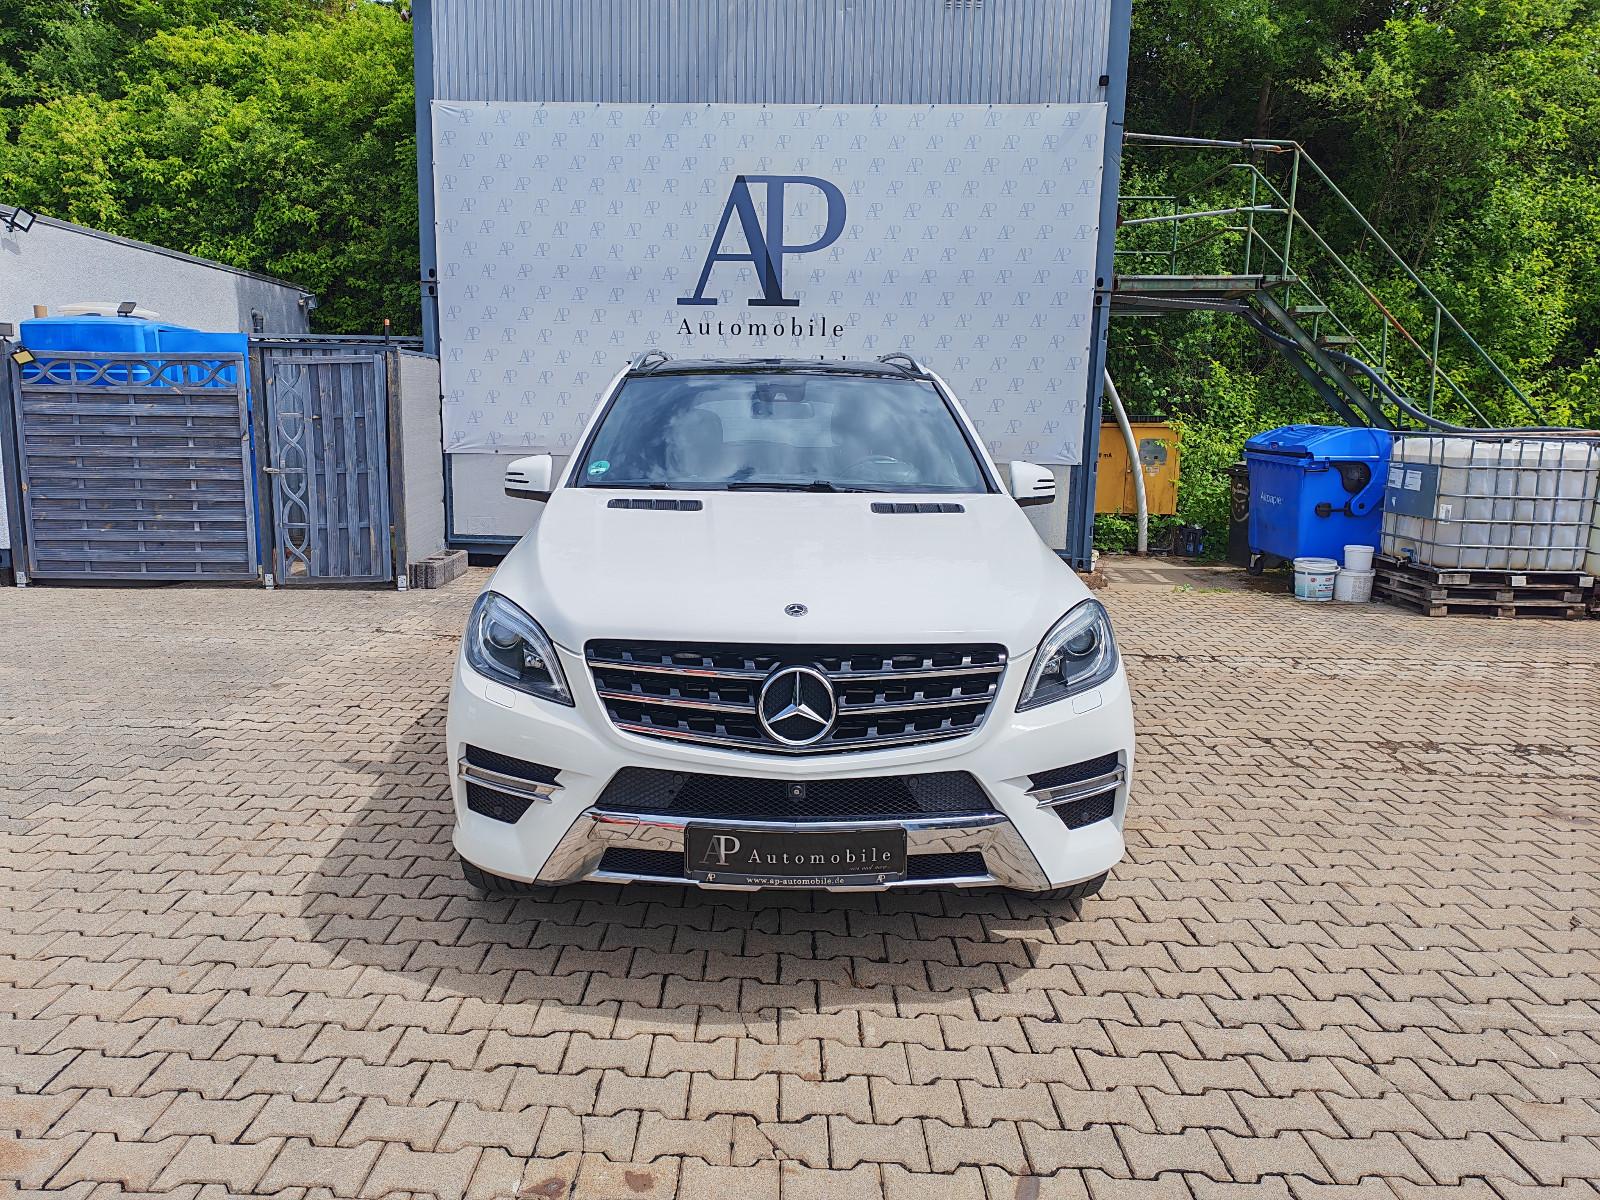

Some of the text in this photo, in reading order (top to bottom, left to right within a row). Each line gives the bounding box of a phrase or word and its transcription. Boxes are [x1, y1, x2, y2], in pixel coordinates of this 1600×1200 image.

[494, 109, 512, 124] AP
[531, 110, 548, 124] AP
[568, 110, 586, 125] AP
[606, 110, 623, 126] AP
[680, 111, 698, 126] AP
[718, 112, 736, 126] AP
[756, 112, 773, 126] AP
[831, 112, 849, 127] AP
[870, 112, 887, 127] AP
[908, 112, 925, 128] AP
[1024, 112, 1041, 126] AP
[439, 130, 456, 145] AP
[476, 131, 494, 146] AP
[550, 132, 568, 147] AP
[587, 133, 604, 148] AP
[624, 133, 642, 148] AP
[699, 134, 716, 149] AP
[736, 134, 754, 149] AP
[774, 134, 792, 149] AP
[850, 135, 867, 150] AP
[926, 135, 943, 150] AP
[964, 135, 982, 150] AP
[1003, 134, 1020, 150] AP
[1080, 134, 1098, 149] AP
[458, 153, 475, 168] AP
[532, 154, 549, 169] AP
[569, 155, 586, 170] AP
[643, 156, 660, 171] AP
[680, 156, 698, 171] AP
[717, 156, 735, 172] AP
[792, 157, 810, 172] AP
[830, 157, 848, 172] AP
[868, 158, 885, 172] AP
[906, 158, 923, 172] AP
[982, 158, 1000, 172] AP
[1021, 157, 1038, 172] AP
[1059, 157, 1077, 172] AP
[477, 175, 494, 190] AP
[514, 176, 531, 191] AP
[551, 177, 568, 192] AP
[624, 178, 642, 193] AP
[661, 178, 679, 193] AP
[848, 180, 866, 195] AP
[886, 180, 903, 195] AP
[924, 180, 941, 195] AP
[1000, 180, 1017, 195] AP
[1038, 180, 1056, 195] AP
[459, 197, 476, 212] AP
[496, 198, 514, 213] AP
[569, 199, 587, 214] AP
[643, 200, 660, 215] AP
[680, 201, 698, 216] AP
[791, 202, 808, 217] AP
[904, 202, 921, 218] AP
[941, 203, 959, 218] AP
[1018, 202, 1035, 218] AP
[1056, 202, 1074, 217] AP
[478, 219, 496, 234] AP
[515, 220, 532, 235] AP
[551, 221, 569, 236] AP
[625, 222, 642, 237] AP
[661, 222, 679, 238] AP
[846, 224, 864, 240] AP
[884, 225, 902, 240] AP
[922, 225, 939, 240] AP
[997, 225, 1015, 240] AP
[1036, 224, 1053, 240] AP
[677, 175, 847, 306] AP
[497, 241, 514, 256] AP
[534, 242, 551, 257] AP
[570, 243, 588, 258] AP
[643, 244, 661, 259] AP
[680, 245, 698, 260] AP
[864, 247, 882, 262] AP
[902, 247, 919, 262] AP
[939, 247, 957, 262] AP
[977, 247, 994, 262] AP
[1015, 247, 1032, 262] AP
[443, 262, 460, 277] AP
[516, 263, 534, 278] AP
[552, 264, 570, 279] AP
[589, 265, 606, 280] AP
[662, 266, 679, 281] AP
[808, 268, 826, 283] AP
[845, 269, 862, 284] AP
[882, 269, 900, 284] AP
[957, 269, 974, 284] AP
[995, 269, 1012, 284] AP
[1033, 269, 1050, 284] AP
[1071, 269, 1088, 284] AP
[462, 284, 480, 299] AP
[571, 286, 588, 301] AP
[607, 287, 625, 302] AP
[643, 288, 661, 302] AP
[826, 290, 844, 305] AP
[863, 291, 880, 306] AP
[937, 291, 955, 306] AP
[975, 291, 992, 306] AP
[1012, 291, 1030, 306] AP
[1051, 291, 1068, 306] AP
[445, 304, 462, 320] AP
[517, 306, 534, 321] AP
[589, 308, 607, 323] AP
[662, 309, 679, 324] AP
[844, 312, 861, 327] AP
[880, 312, 898, 327] AP
[676, 316, 844, 336] Automobile
[955, 313, 972, 328] AP
[992, 313, 1010, 328] AP
[1068, 313, 1085, 328] AP
[463, 326, 481, 341] AP
[499, 327, 517, 342] AP
[572, 329, 589, 344] AP
[608, 329, 625, 344] AP
[861, 334, 879, 349] AP
[898, 334, 916, 349] AP
[935, 334, 952, 349] AP
[1010, 334, 1027, 349] AP
[1047, 334, 1065, 349] AP
[446, 347, 464, 362] AP
[518, 348, 536, 363] AP
[554, 349, 572, 364] AP
[590, 350, 607, 365] AP
[990, 356, 1007, 371] AP
[1027, 356, 1044, 371] AP
[1065, 356, 1082, 371] AP
[465, 368, 482, 383] AP
[536, 370, 554, 385] AP
[970, 377, 988, 392] AP
[1007, 377, 1024, 392] AP
[1045, 377, 1062, 392] AP
[483, 389, 501, 404] AP
[519, 390, 536, 405] AP
[987, 398, 1005, 413] AP
[1025, 398, 1042, 413] AP
[1062, 399, 1080, 414] AP
[502, 410, 519, 425] AP
[537, 411, 555, 426] AP
[1004, 419, 1022, 434] AP
[1042, 419, 1059, 434] AP
[484, 430, 502, 445] AP
[1022, 440, 1039, 455] AP
[699, 835, 740, 865] AP
[748, 848, 891, 864] Automobile
[746, 877, 845, 885] www.ap-automobile.de
